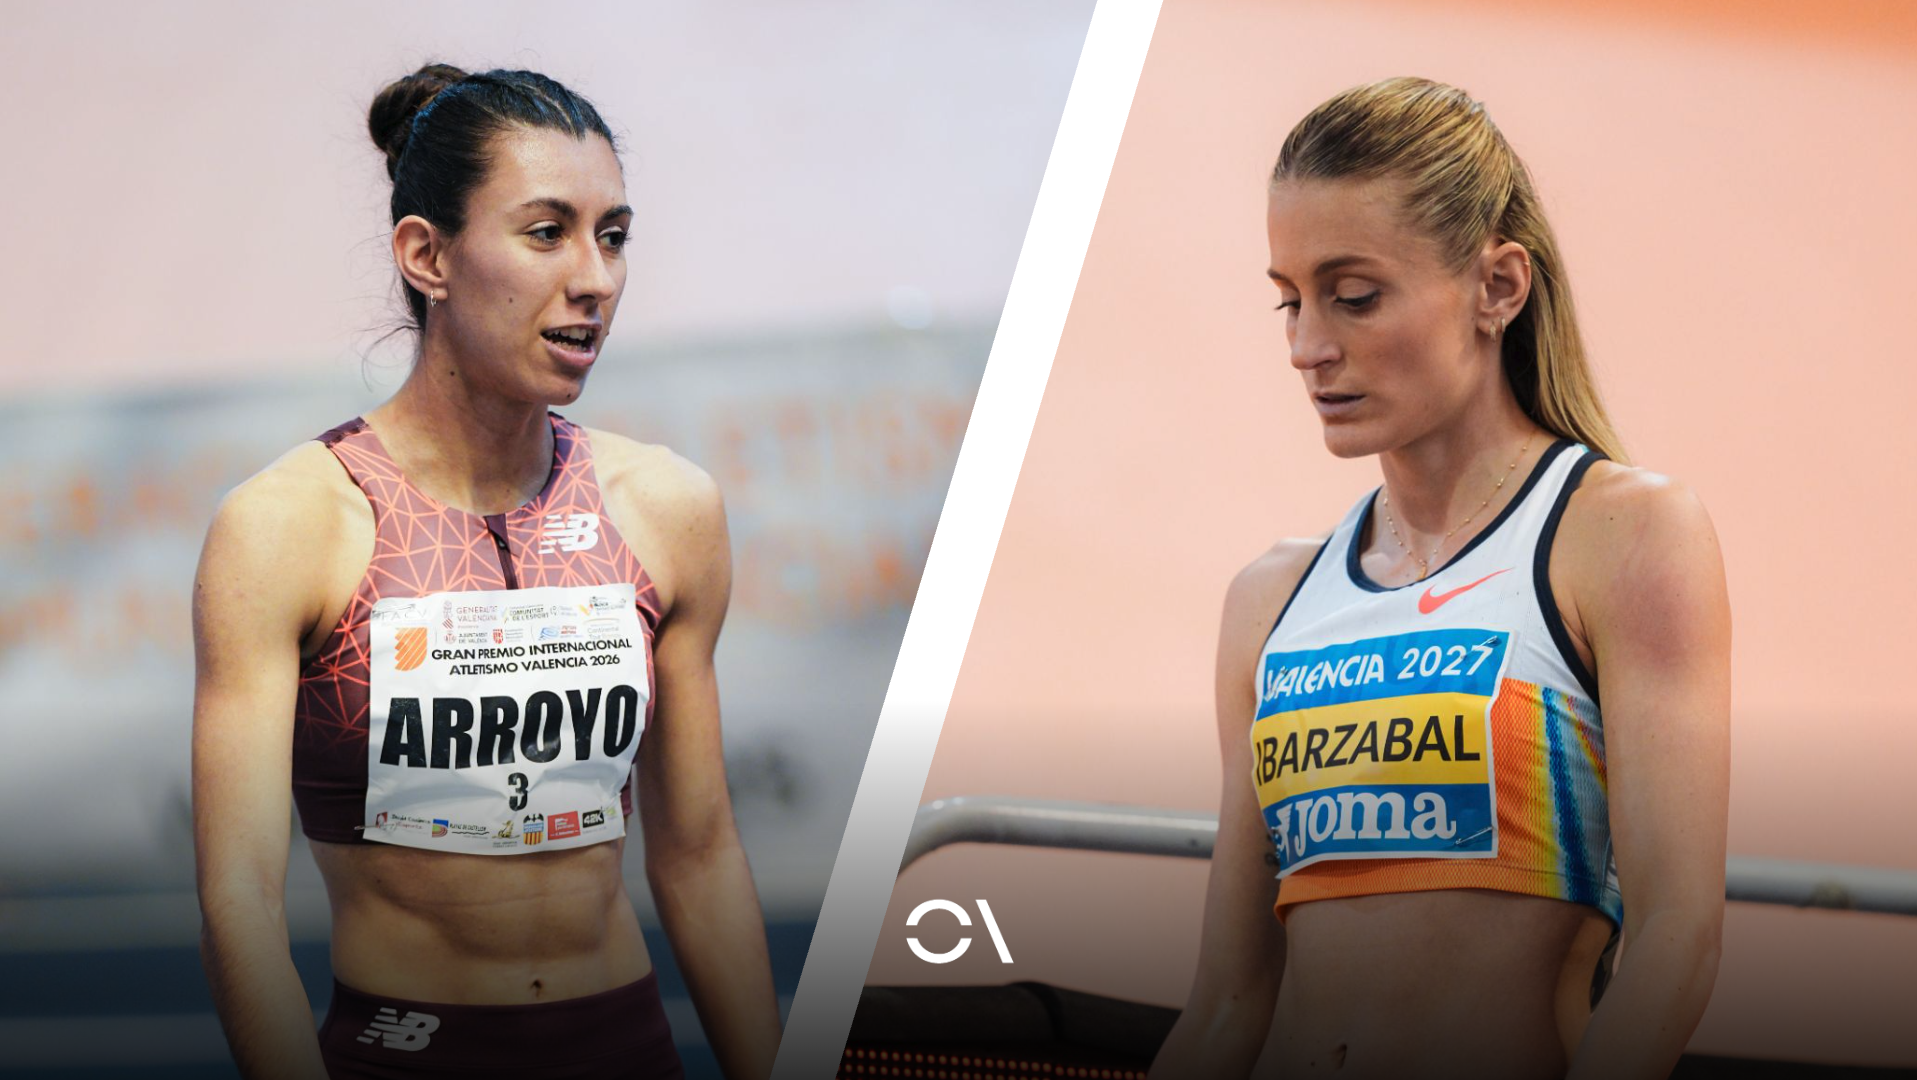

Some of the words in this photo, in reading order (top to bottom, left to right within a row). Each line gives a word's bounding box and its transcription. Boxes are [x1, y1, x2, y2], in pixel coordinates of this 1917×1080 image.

[431, 648, 476, 660] GRAN
[478, 645, 525, 659] PREMIO
[529, 638, 632, 656] INTERNACIONAL
[449, 661, 518, 675] ATLETISMO
[521, 656, 588, 672] VALENCIA
[591, 654, 621, 667] 2026
[1263, 654, 1385, 702] VALENCIA
[1397, 645, 1494, 681] 2027
[379, 684, 639, 770] ARROYO
[1256, 714, 1481, 787] IBARZABAL
[507, 772, 529, 812] 3
[583, 811, 604, 825] 42K
[1294, 791, 1457, 857] Joma
